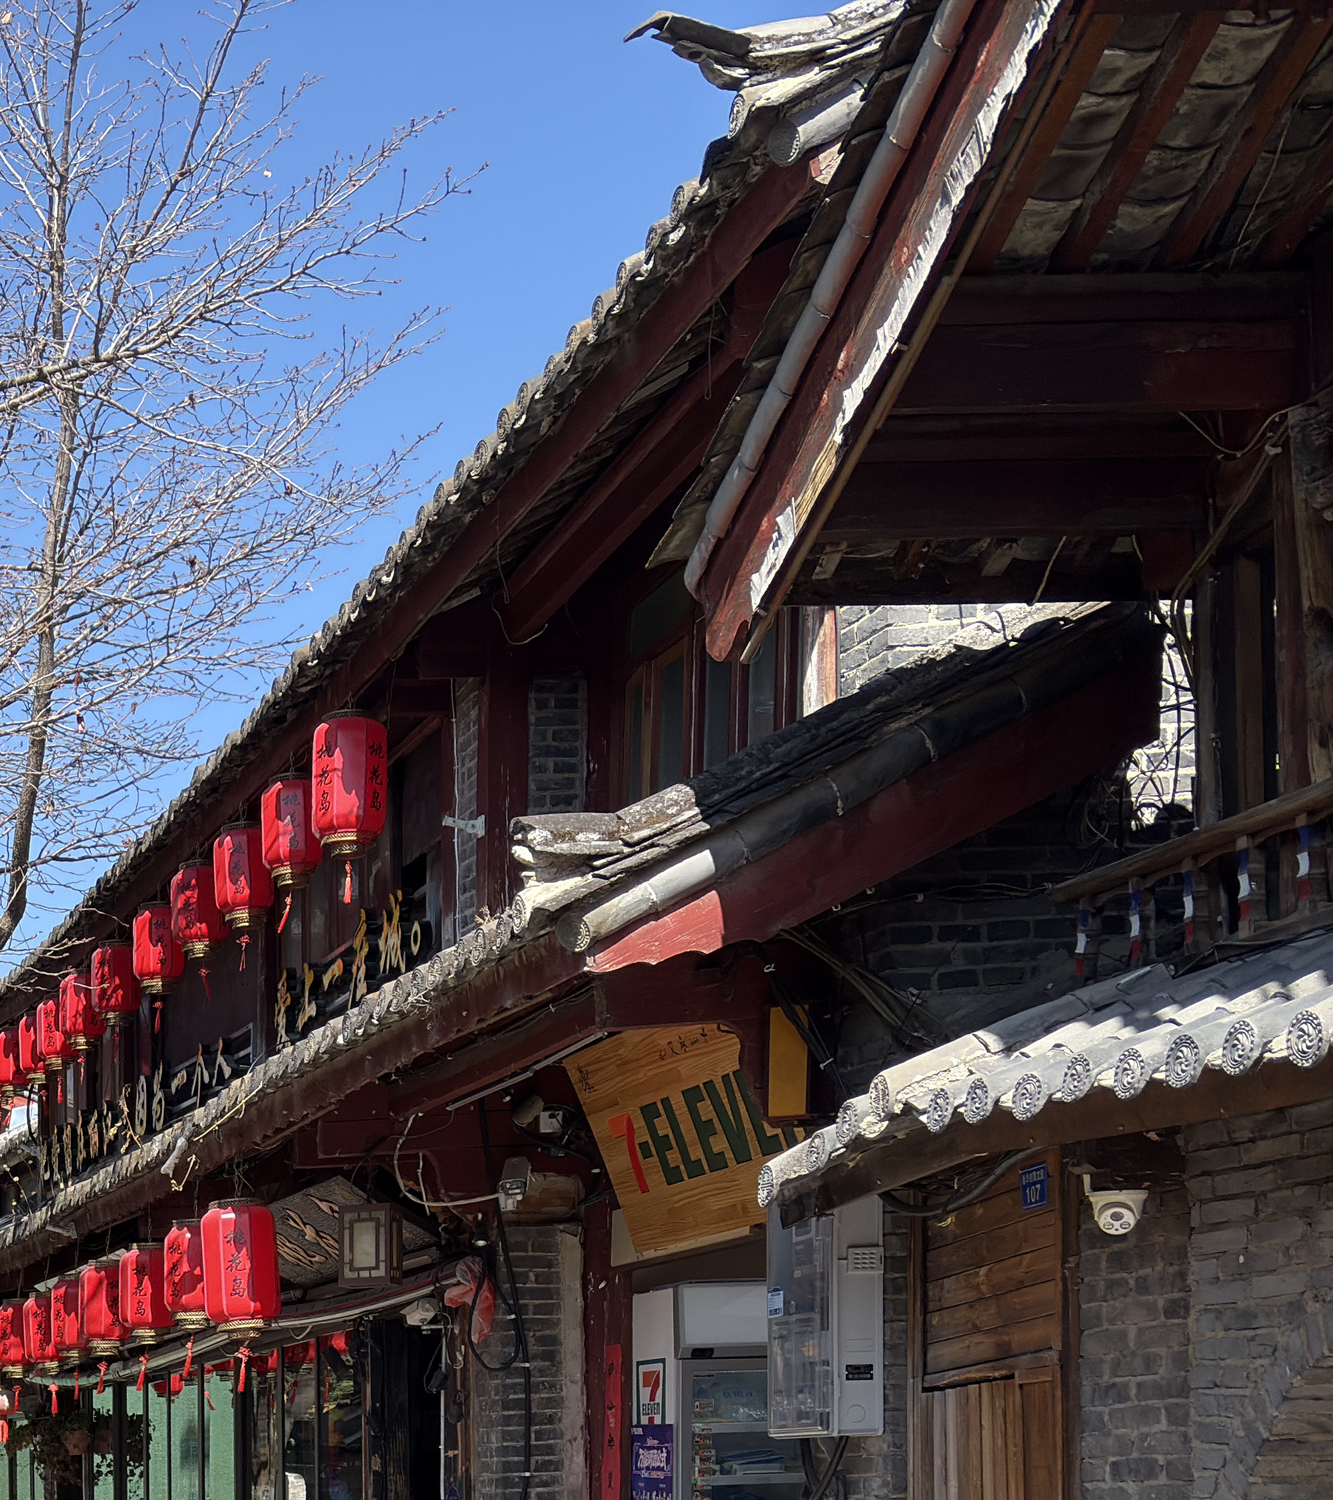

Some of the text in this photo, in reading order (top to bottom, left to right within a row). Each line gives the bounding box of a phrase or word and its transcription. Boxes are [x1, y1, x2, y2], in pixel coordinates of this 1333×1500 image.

[316, 744, 334, 813] 桃花岛
[369, 742, 386, 812] 桃花岛
[283, 793, 301, 849] 桃花岛
[44, 1008, 56, 1049] 桃花岛
[1025, 1183, 1041, 1204] 107
[132, 1264, 148, 1317] 桃花岛
[168, 1241, 183, 1299] 桃花岛
[224, 1227, 248, 1298] 桃花岛
[53, 1292, 64, 1341] 桃花岛
